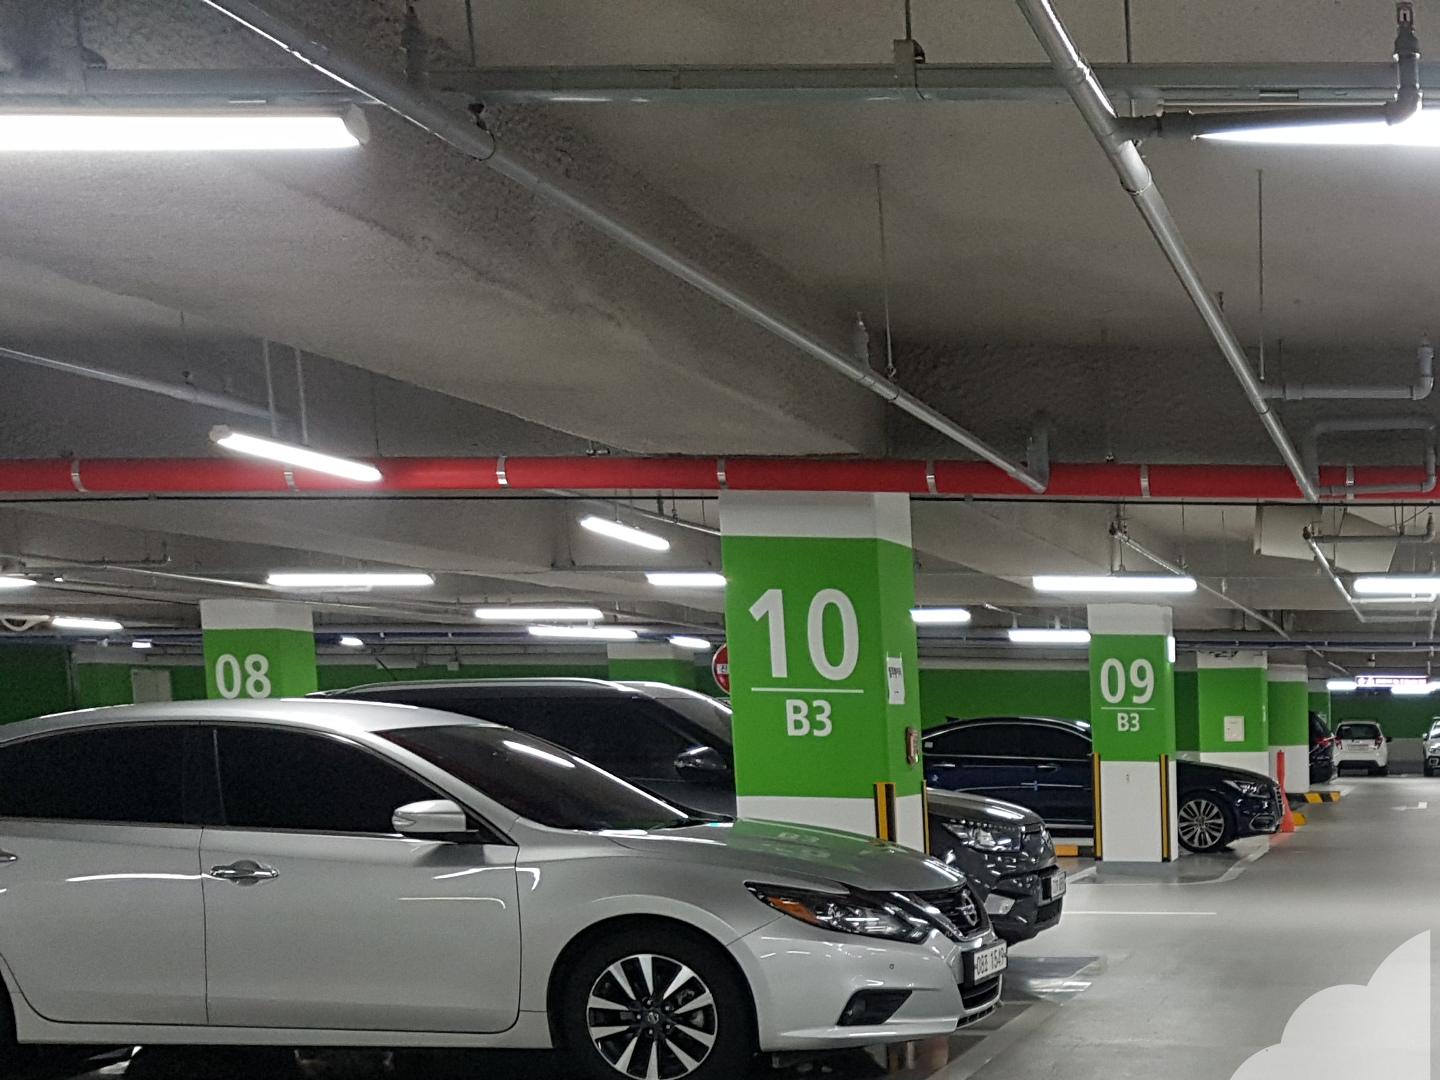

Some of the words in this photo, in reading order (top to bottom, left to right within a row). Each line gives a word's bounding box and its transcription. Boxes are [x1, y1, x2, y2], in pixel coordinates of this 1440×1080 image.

[749, 588, 859, 681] 10
[214, 653, 272, 699] 08
[1100, 658, 1154, 705] 09
[786, 699, 832, 737] B3
[1117, 712, 1140, 732] B3
